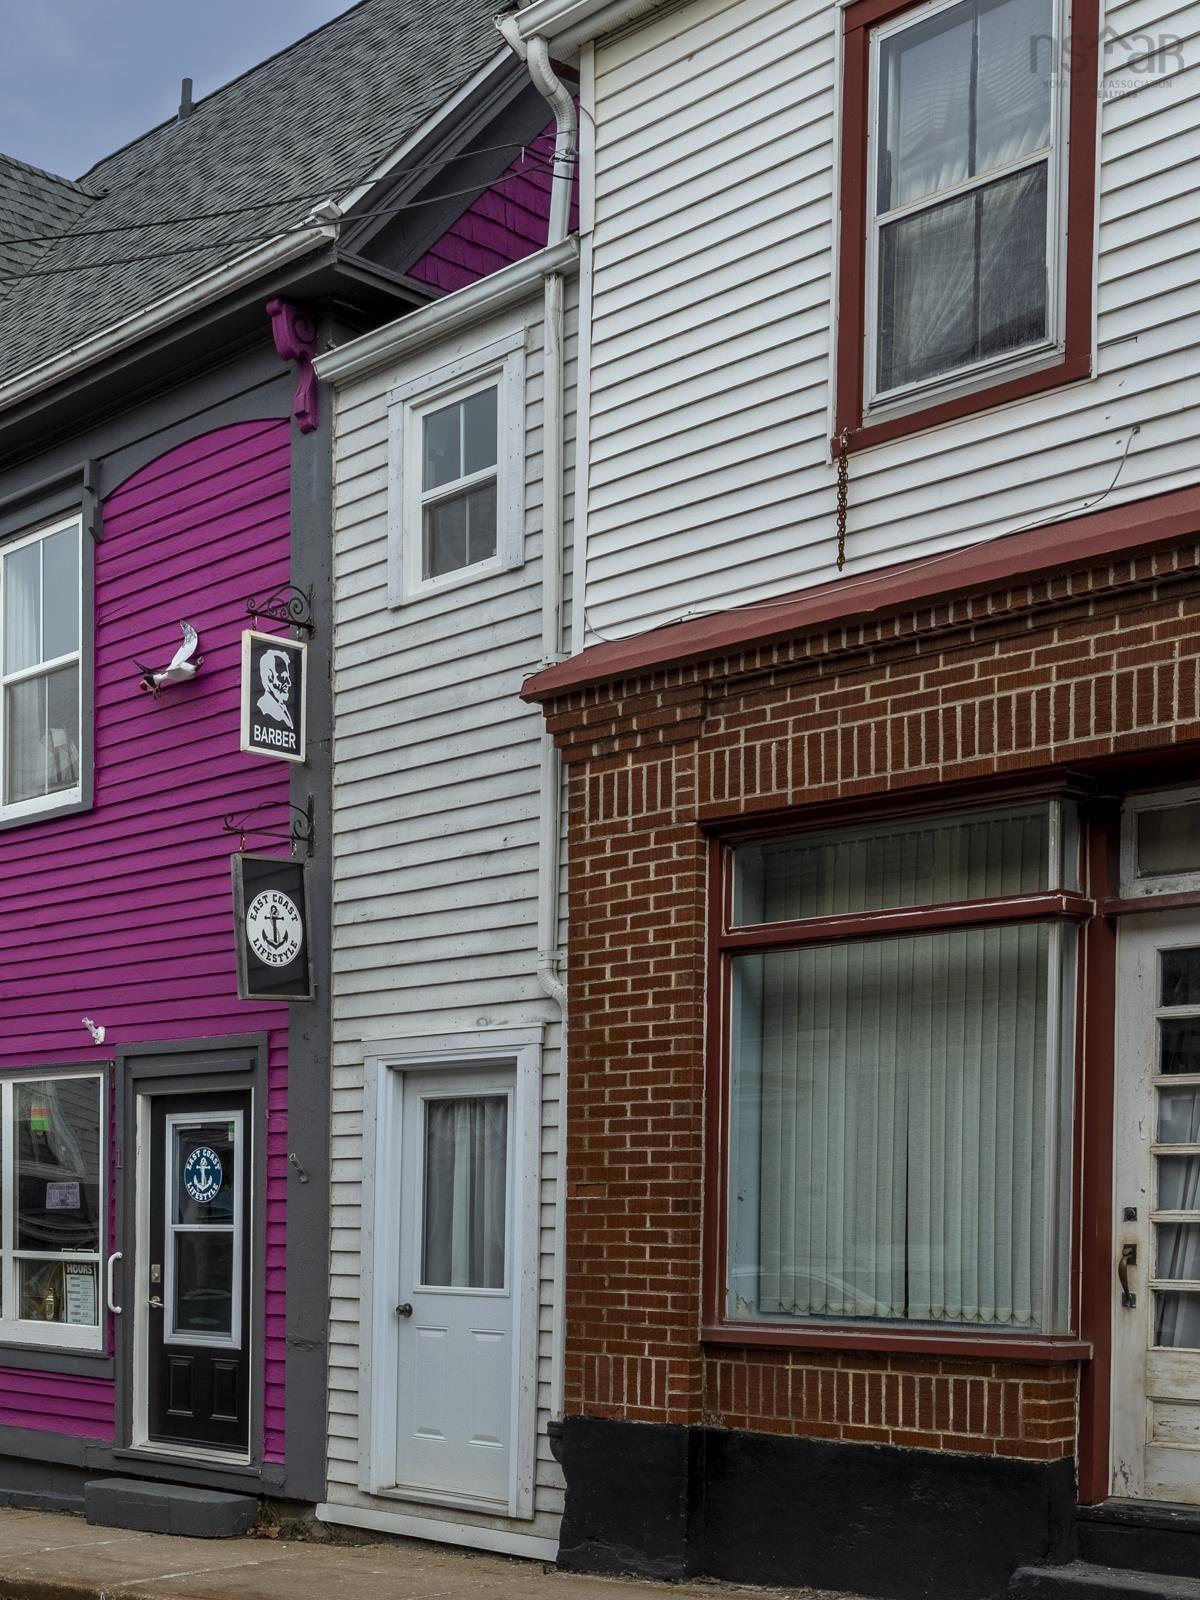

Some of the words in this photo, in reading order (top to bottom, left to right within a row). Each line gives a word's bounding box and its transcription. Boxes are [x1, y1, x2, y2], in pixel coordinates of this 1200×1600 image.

[254, 724, 296, 749] BARBER
[249, 894, 269, 922] EAST
[272, 893, 299, 922] COAST
[252, 937, 298, 963] LIFESTYLE
[186, 1150, 201, 1171] EAST
[202, 1148, 221, 1170] COAST
[186, 1181, 219, 1201] LIFESTYLE
[66, 1263, 93, 1274] HOURS
